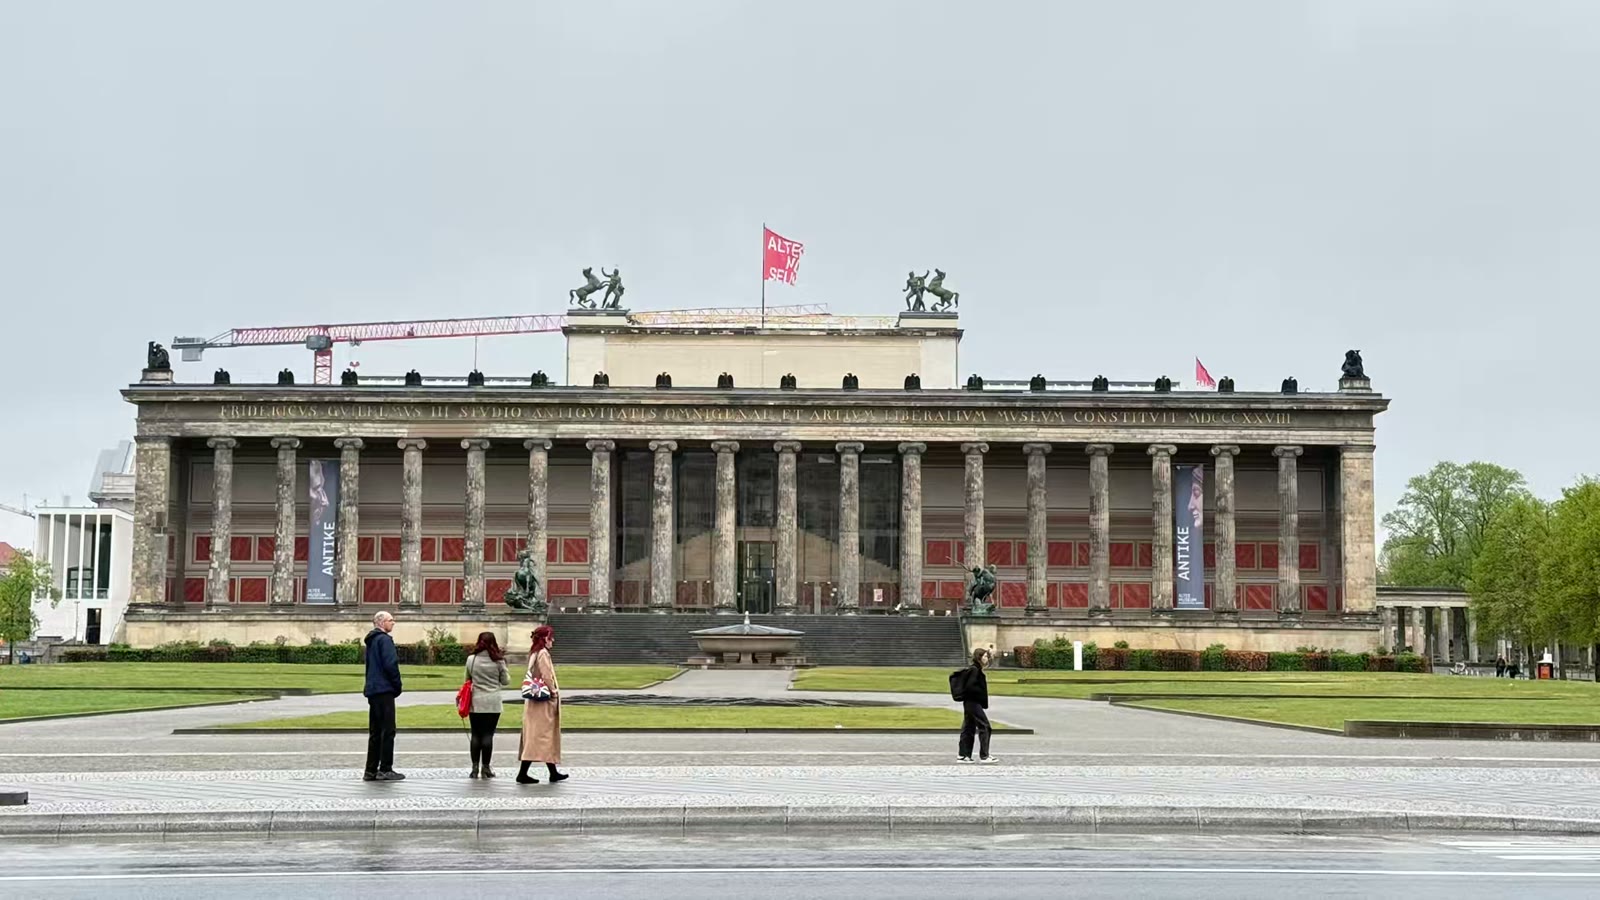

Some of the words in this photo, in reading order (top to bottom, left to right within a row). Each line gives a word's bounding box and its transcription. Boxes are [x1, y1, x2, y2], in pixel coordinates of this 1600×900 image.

[220, 405, 318, 418] FRIDERICVS
[431, 406, 449, 418] III
[458, 406, 522, 418] STVDIO
[531, 407, 657, 419] ANTIQVITATIS
[782, 409, 803, 420] ET
[810, 409, 876, 421] ARTIVM
[885, 410, 986, 422] LIBERALIVM
[998, 410, 1065, 422] MVSEVM
[1073, 411, 1178, 423] CONSTITVIT
[1186, 412, 1291, 424] MDCCCXXVIII
[322, 521, 335, 576] ANTIKE
[1177, 526, 1190, 581] ANTIKE
